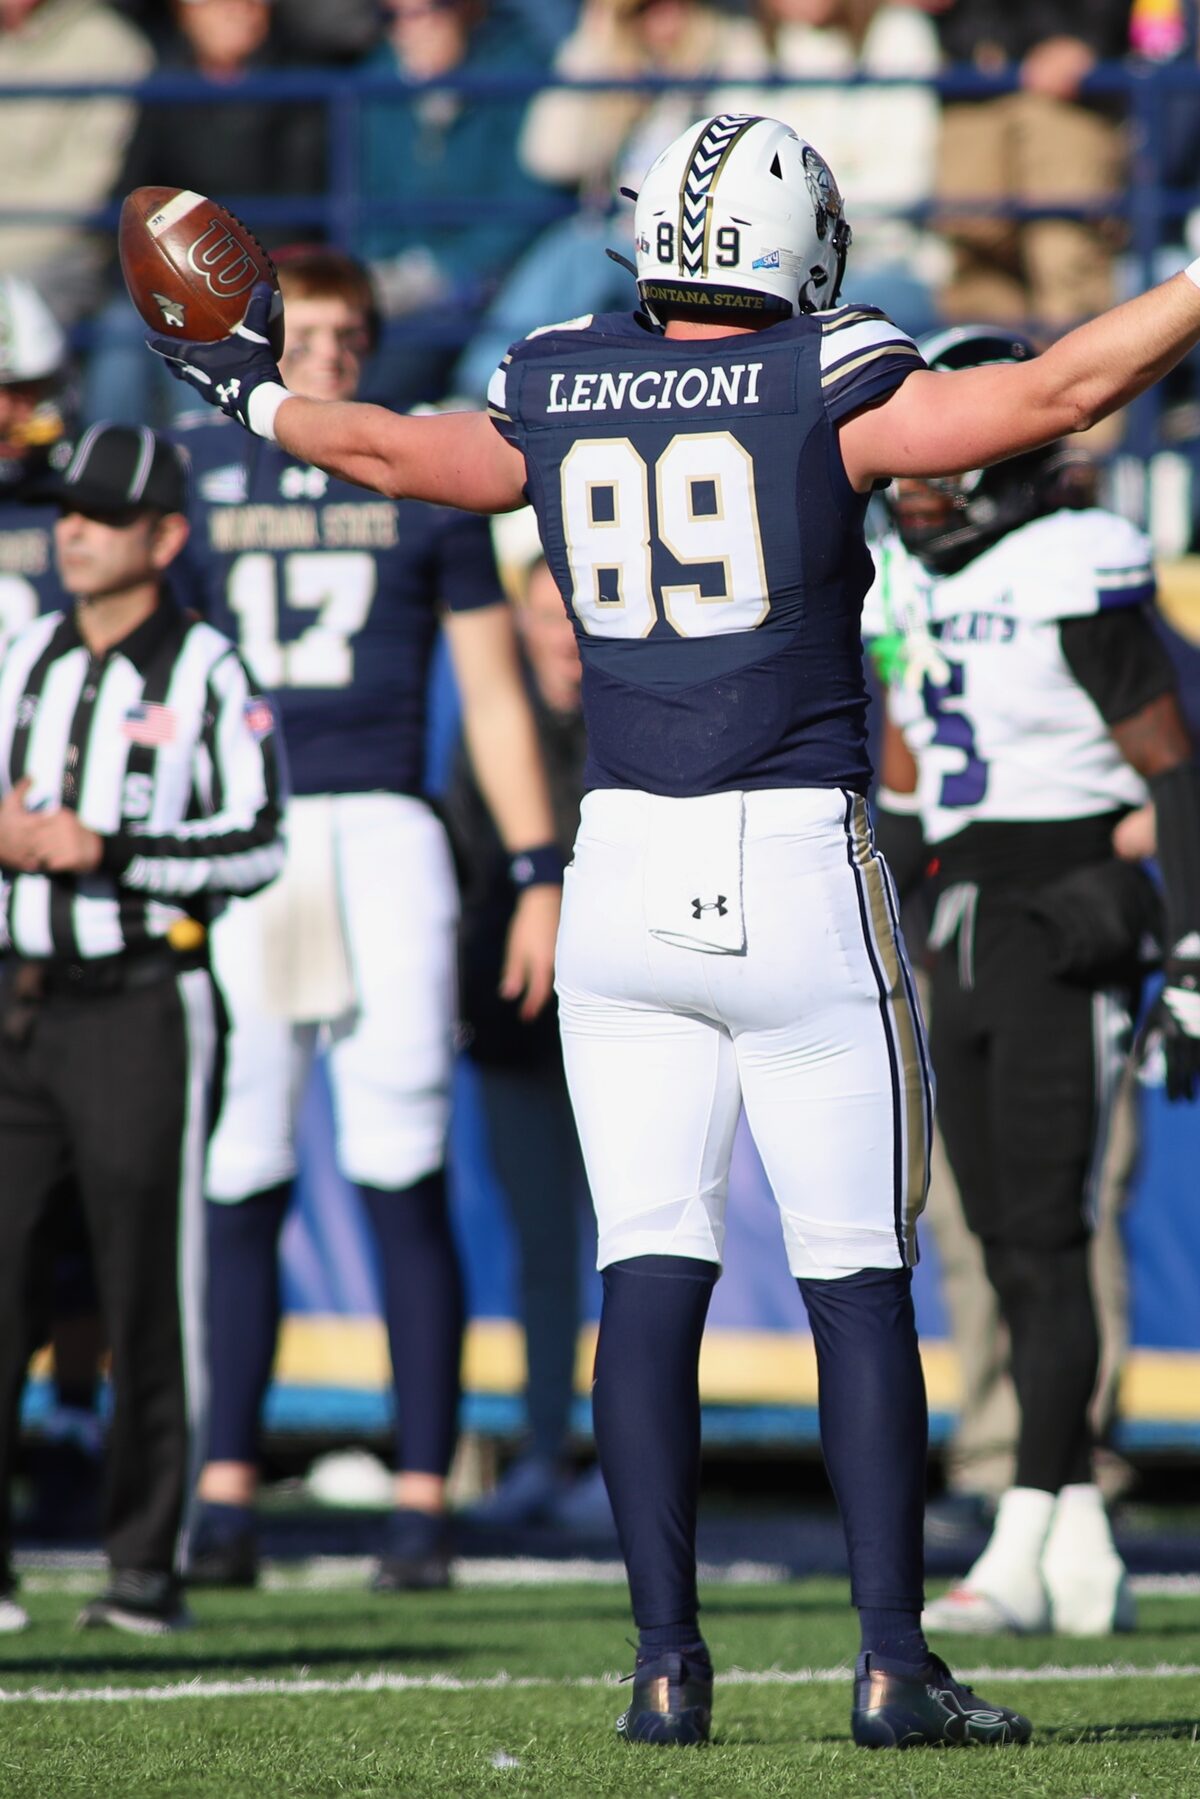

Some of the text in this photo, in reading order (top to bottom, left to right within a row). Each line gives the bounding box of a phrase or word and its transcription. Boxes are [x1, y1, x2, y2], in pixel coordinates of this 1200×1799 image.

[656, 221, 674, 263] 8
[716, 226, 740, 267] 9
[762, 250, 780, 267] SKY
[713, 293, 765, 310] STATE
[546, 362, 763, 413] LENCIONI
[320, 502, 399, 549] STATE
[559, 431, 771, 639] 89
[227, 551, 378, 689] 17
[920, 661, 989, 809] 5
[122, 771, 154, 819] S
